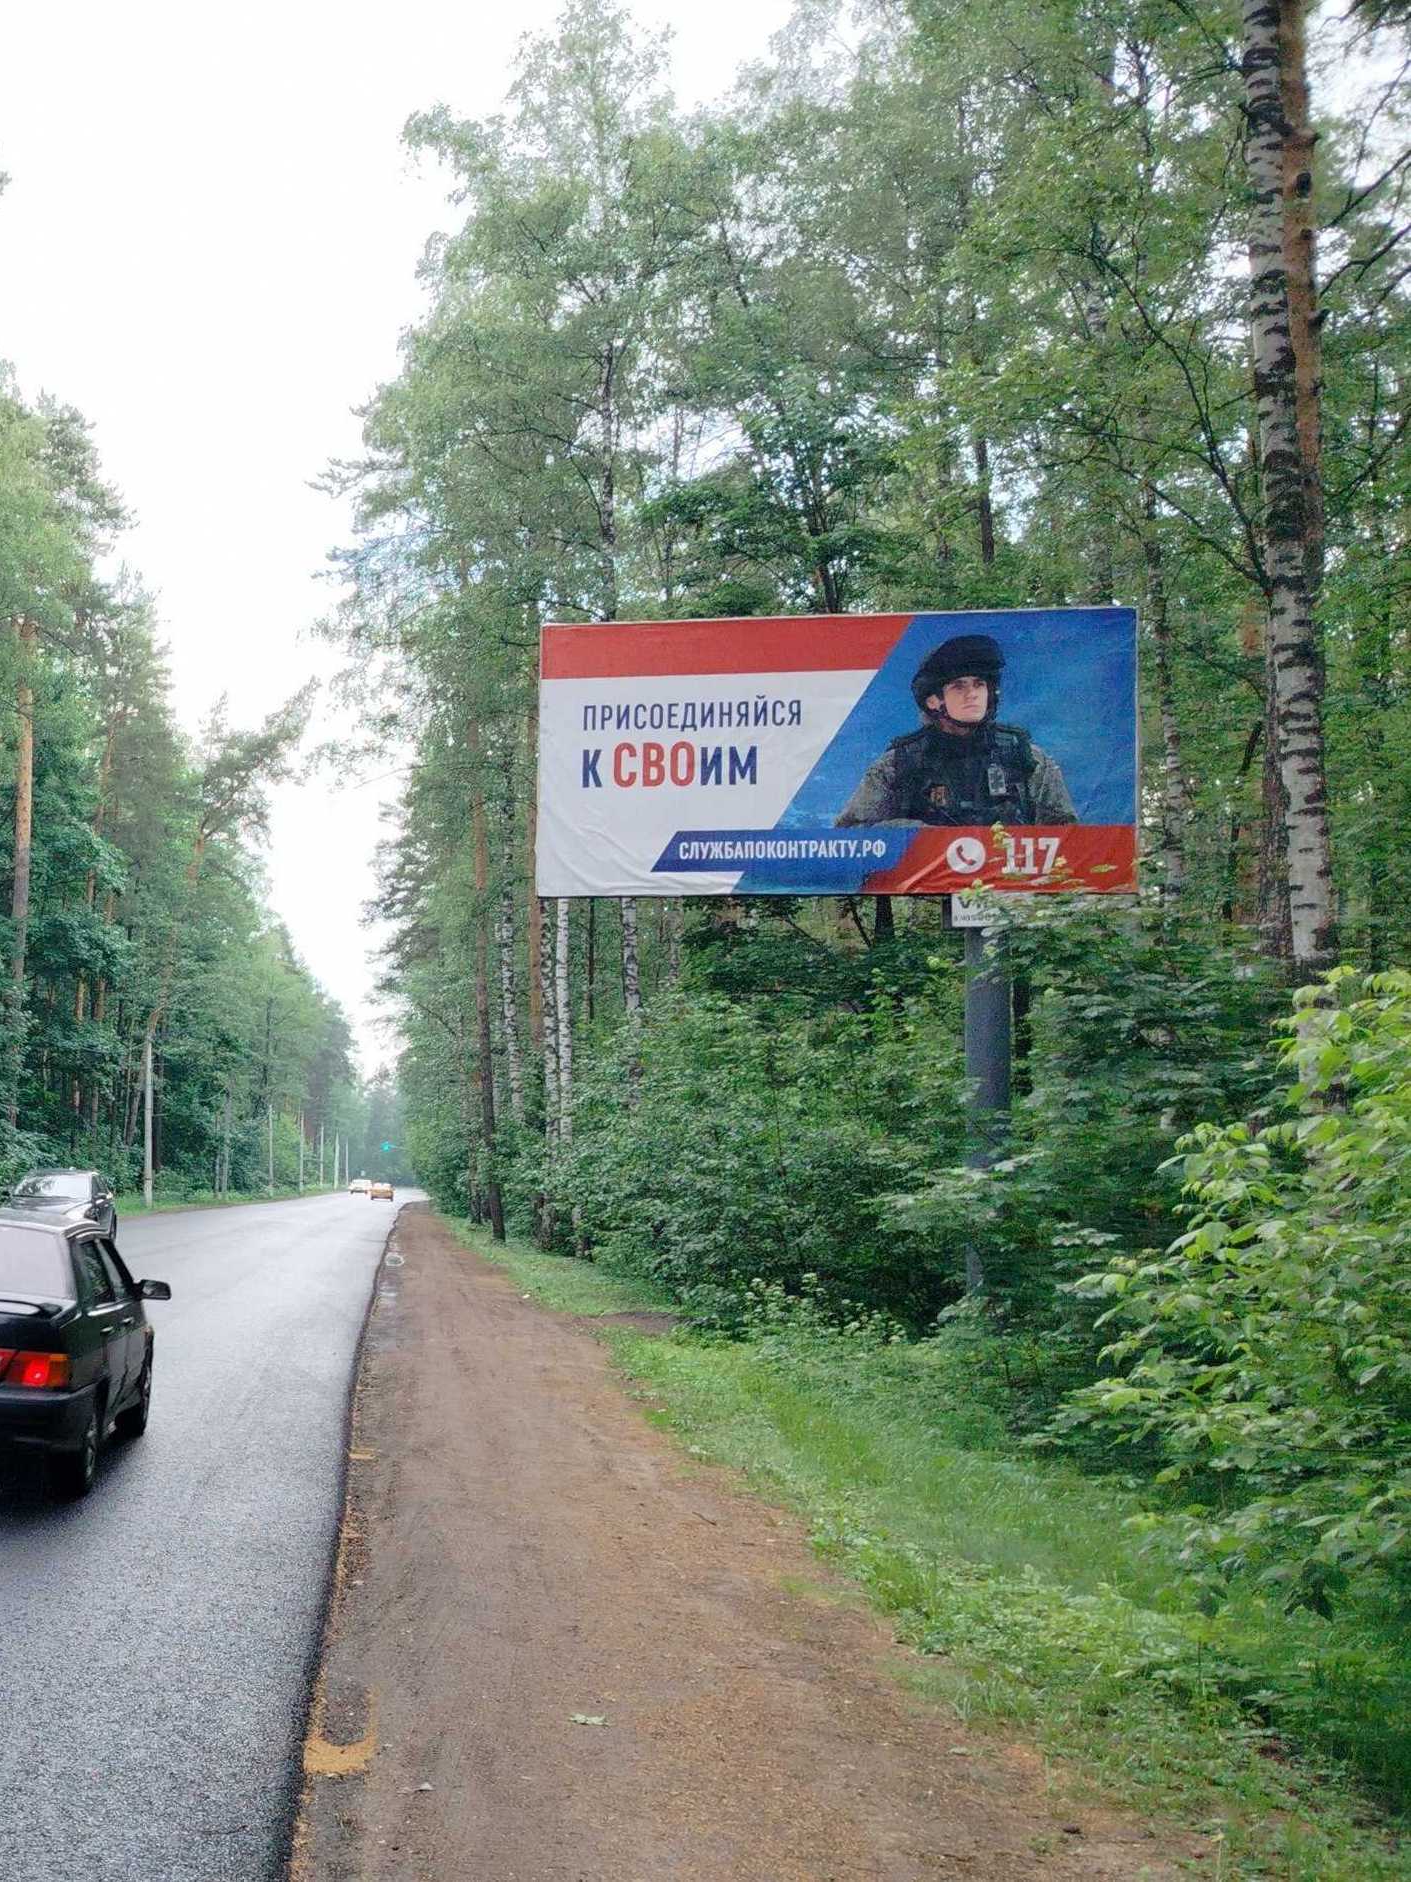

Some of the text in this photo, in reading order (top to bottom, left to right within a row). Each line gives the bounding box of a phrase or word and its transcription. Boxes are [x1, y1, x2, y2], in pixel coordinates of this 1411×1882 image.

[583, 695, 802, 732] ПРИСОЕДИНЯЙСЯ
[582, 741, 758, 788] К СВОИМ
[679, 839, 887, 860] СЛУЖБАПОКОНТРАКТУ.РФ
[1001, 837, 1061, 875] 117
